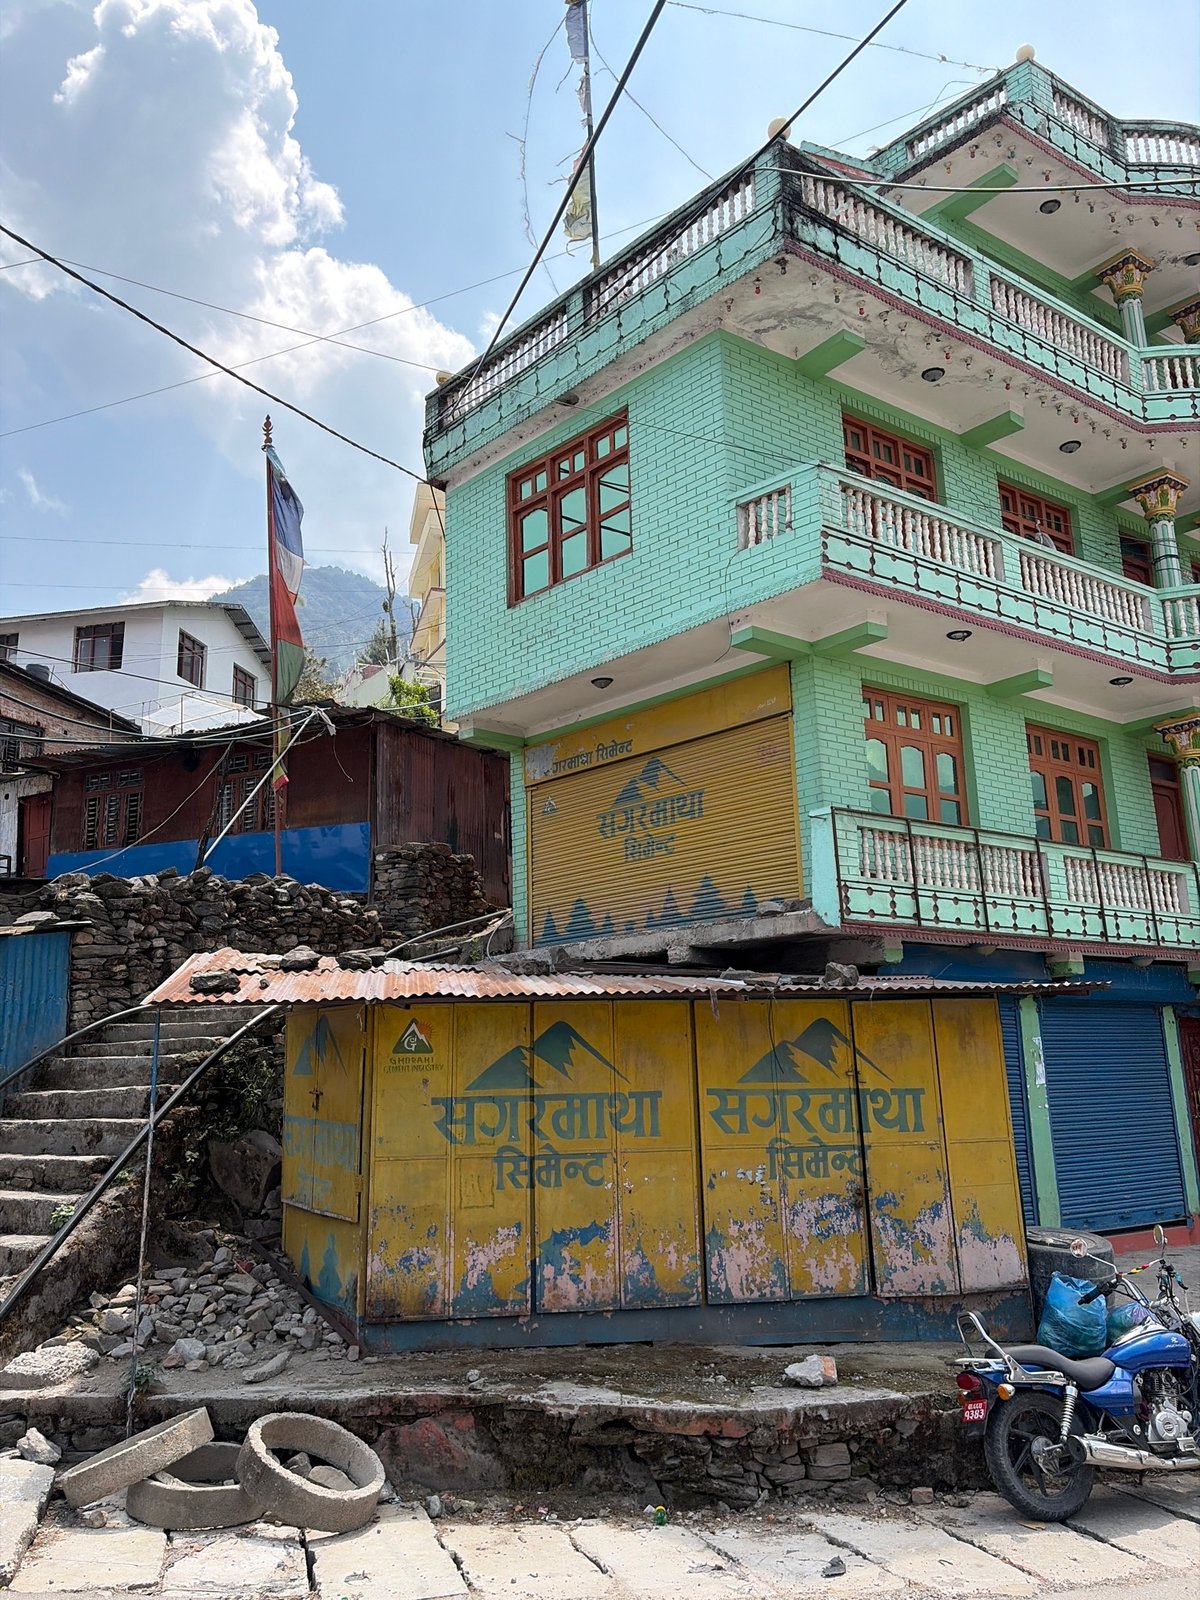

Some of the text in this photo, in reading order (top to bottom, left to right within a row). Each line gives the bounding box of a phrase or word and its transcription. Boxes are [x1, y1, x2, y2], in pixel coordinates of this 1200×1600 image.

[596, 788, 704, 839] सगरमाथा
[431, 1090, 663, 1145] सगरमाथा
[705, 1087, 926, 1134] सगरमाथा
[493, 1143, 608, 1190] सिमेन्ट
[766, 1135, 872, 1180] सिमेन्ट
